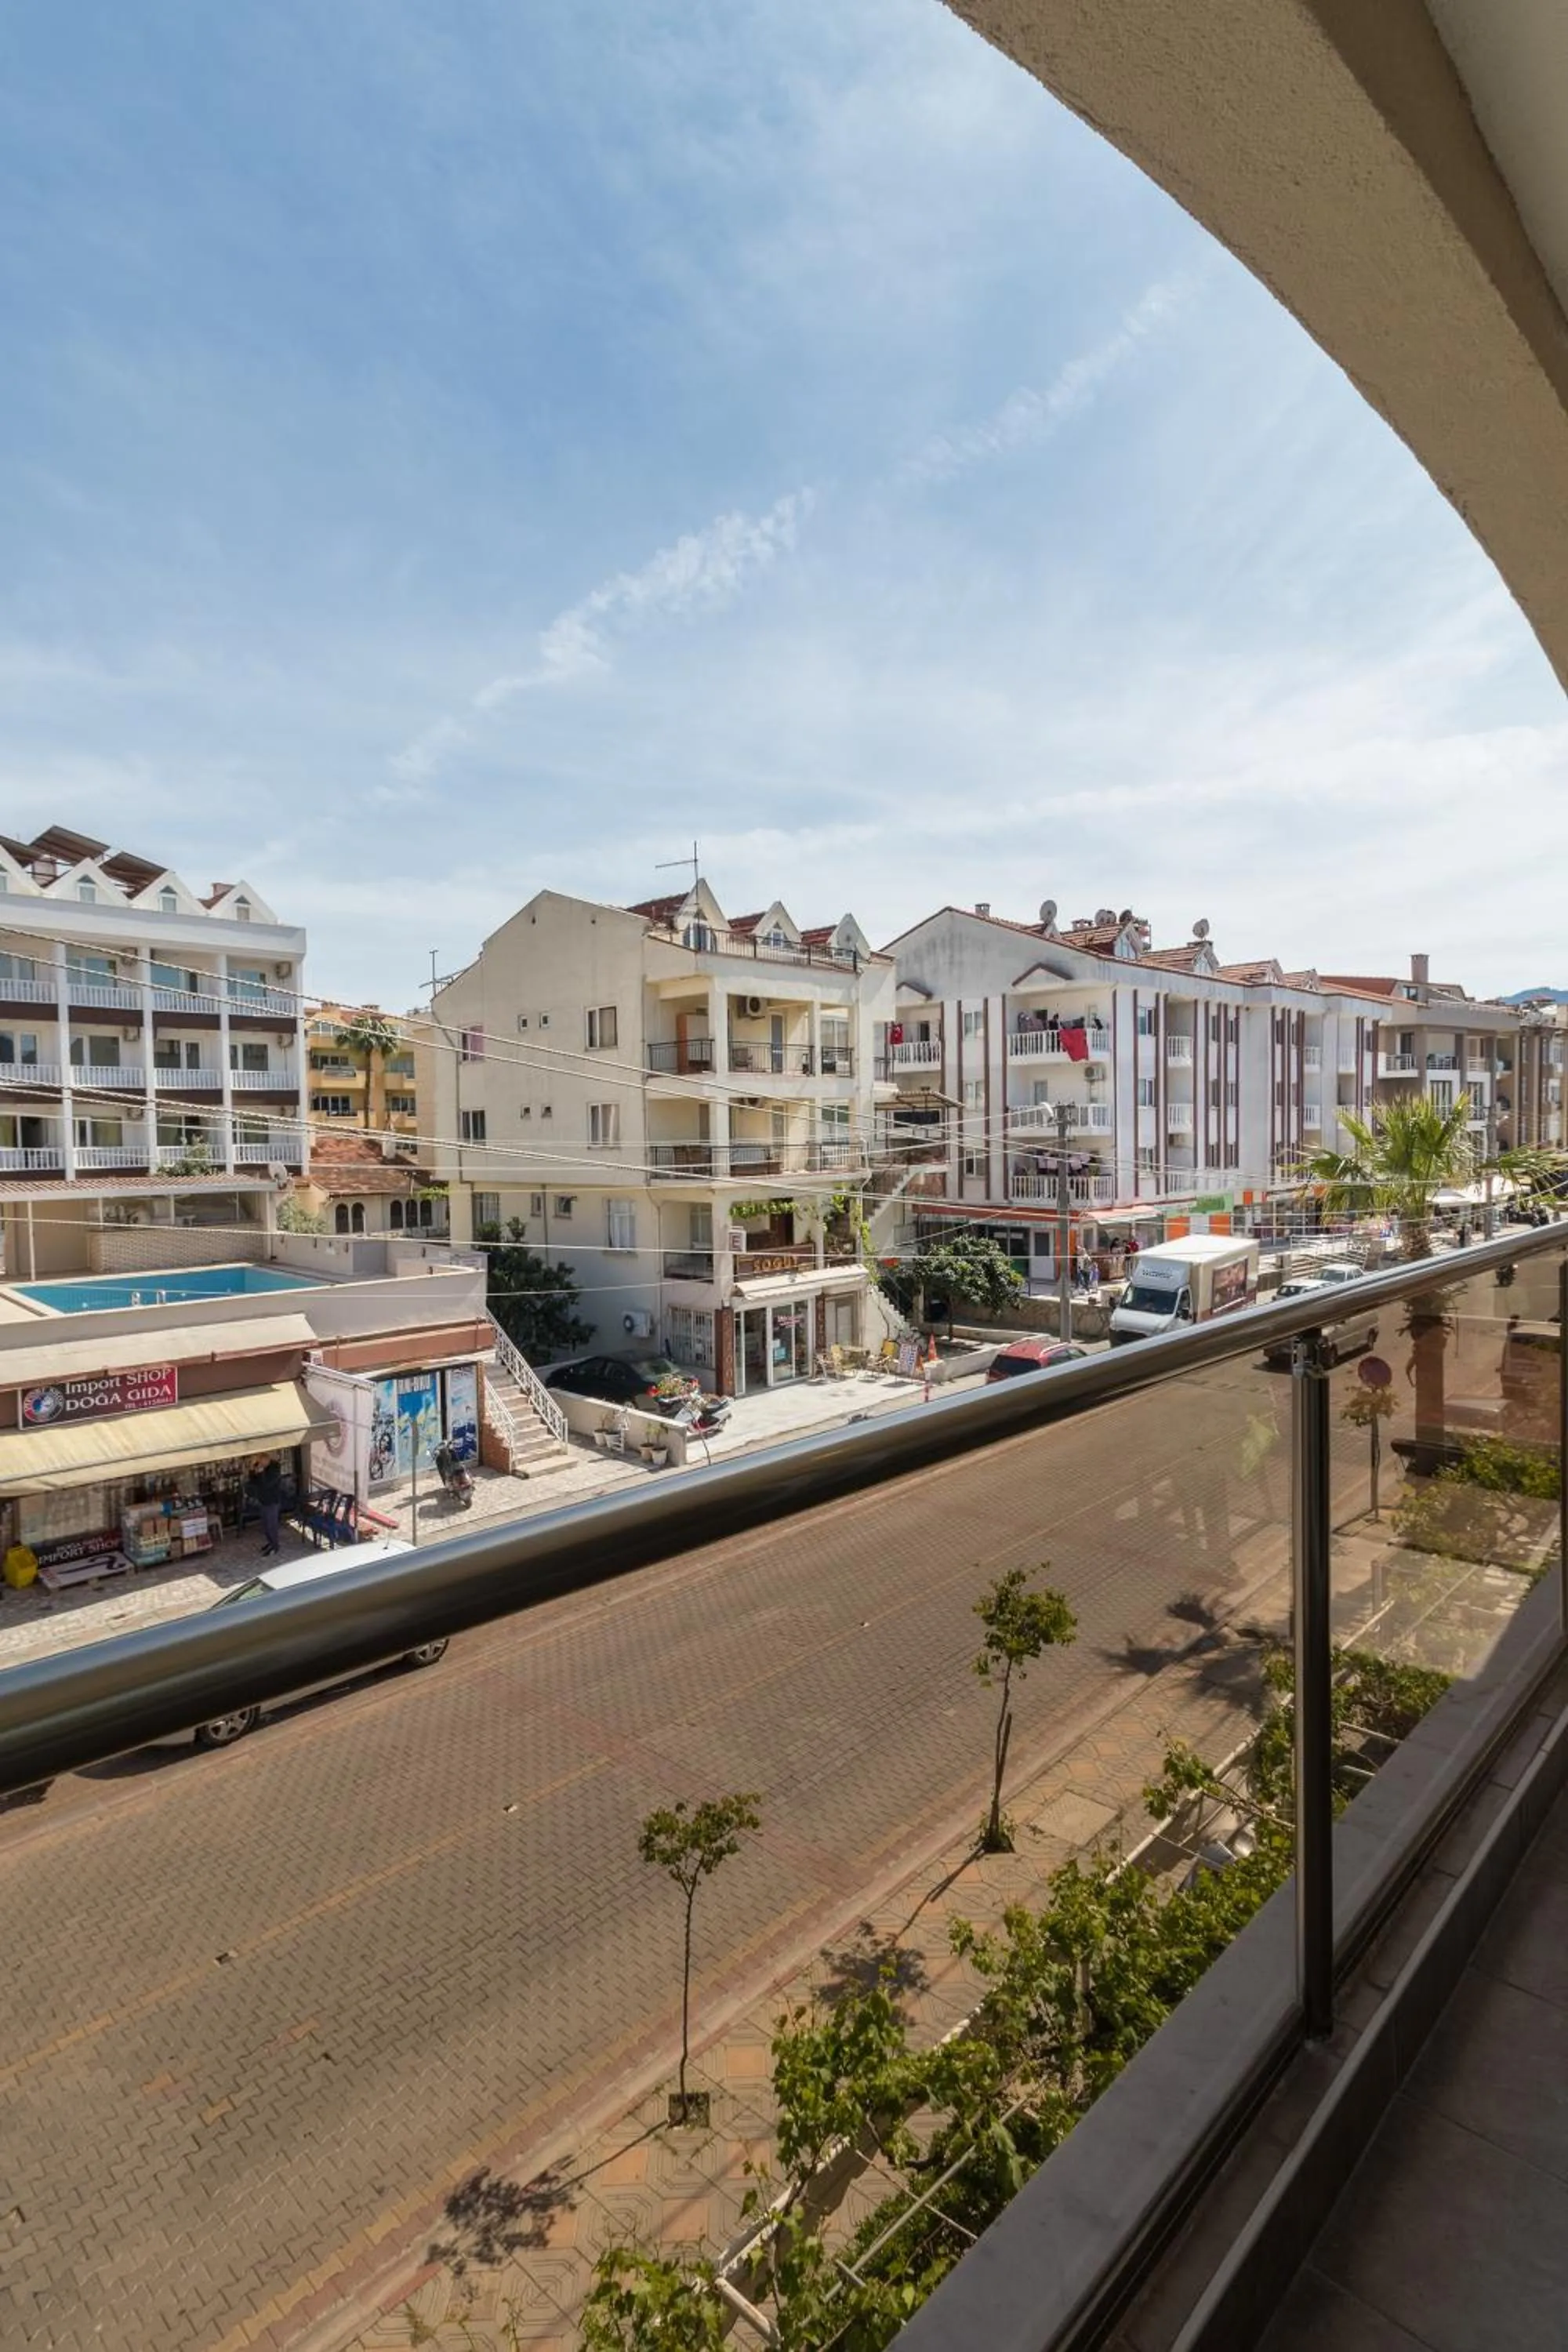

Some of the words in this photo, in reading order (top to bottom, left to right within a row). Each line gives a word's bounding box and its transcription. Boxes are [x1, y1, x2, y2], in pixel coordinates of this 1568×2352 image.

[65, 1377, 121, 1395] Import
[126, 1368, 172, 1386] SHOP
[127, 1385, 172, 1401] GIDA
